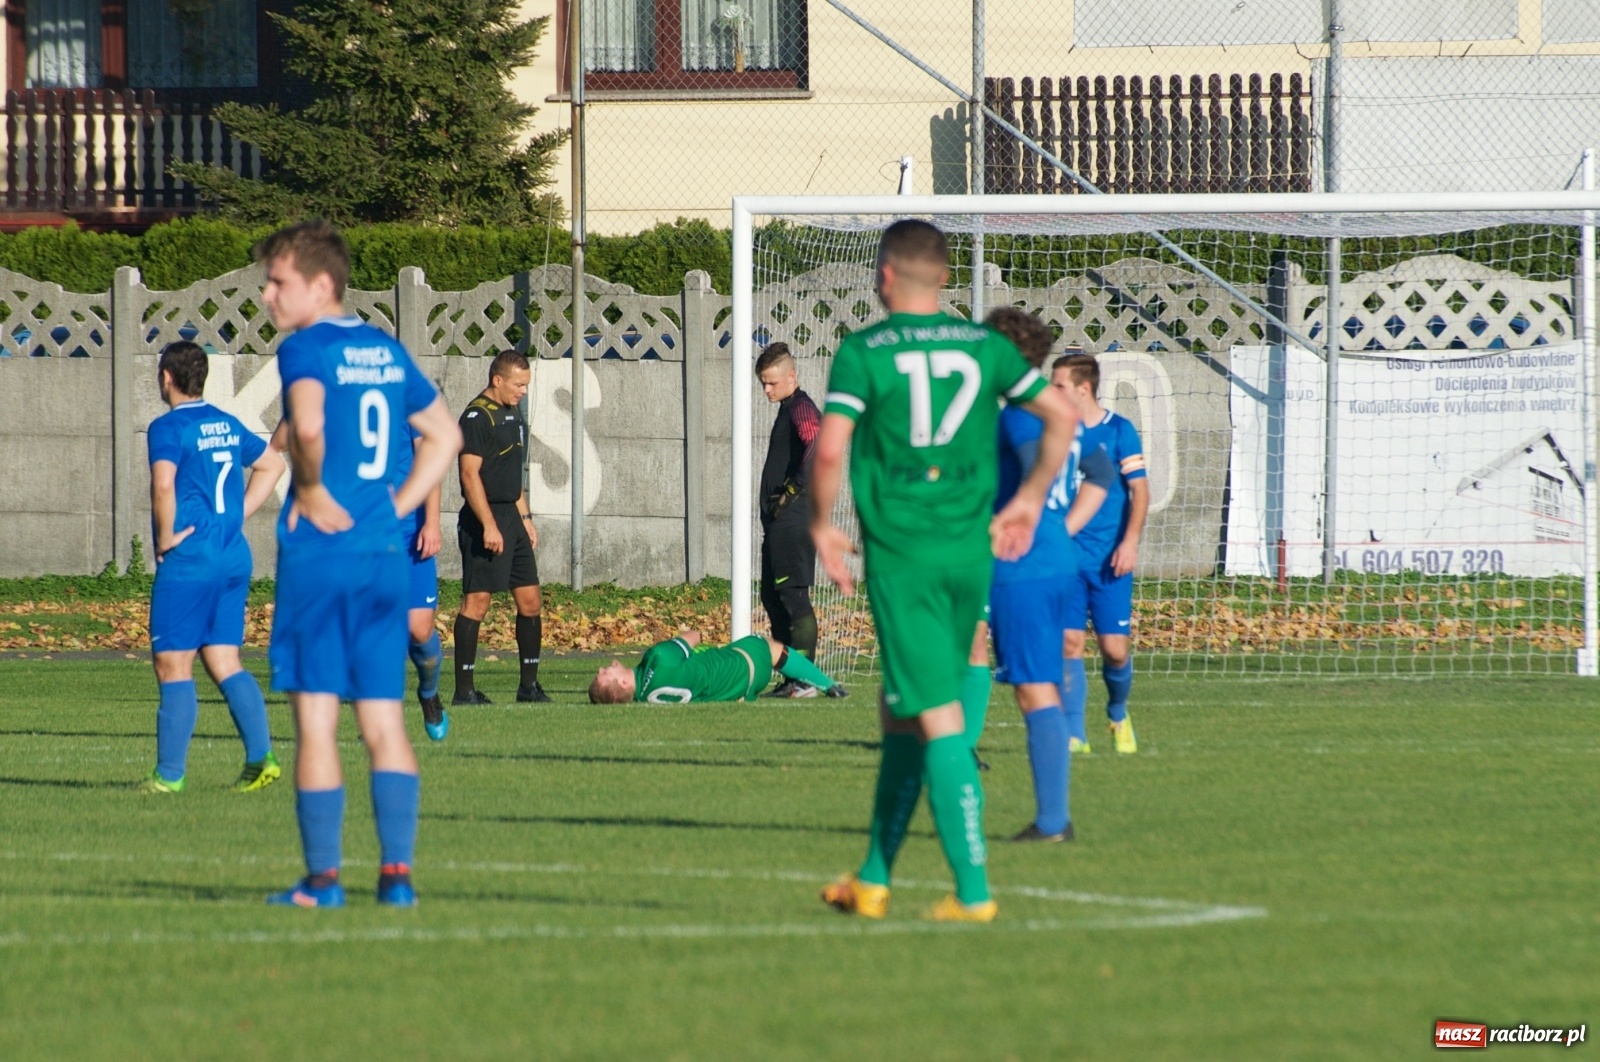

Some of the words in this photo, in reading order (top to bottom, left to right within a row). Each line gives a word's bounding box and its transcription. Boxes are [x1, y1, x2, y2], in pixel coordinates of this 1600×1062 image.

[894, 351, 982, 447] 17
[1350, 399, 1440, 417] Kompleksowe
[357, 388, 390, 480] 9
[212, 451, 233, 514] 7
[1362, 550, 1401, 573] 604
[1412, 550, 1454, 574] 507
[1462, 550, 1504, 573] 320
